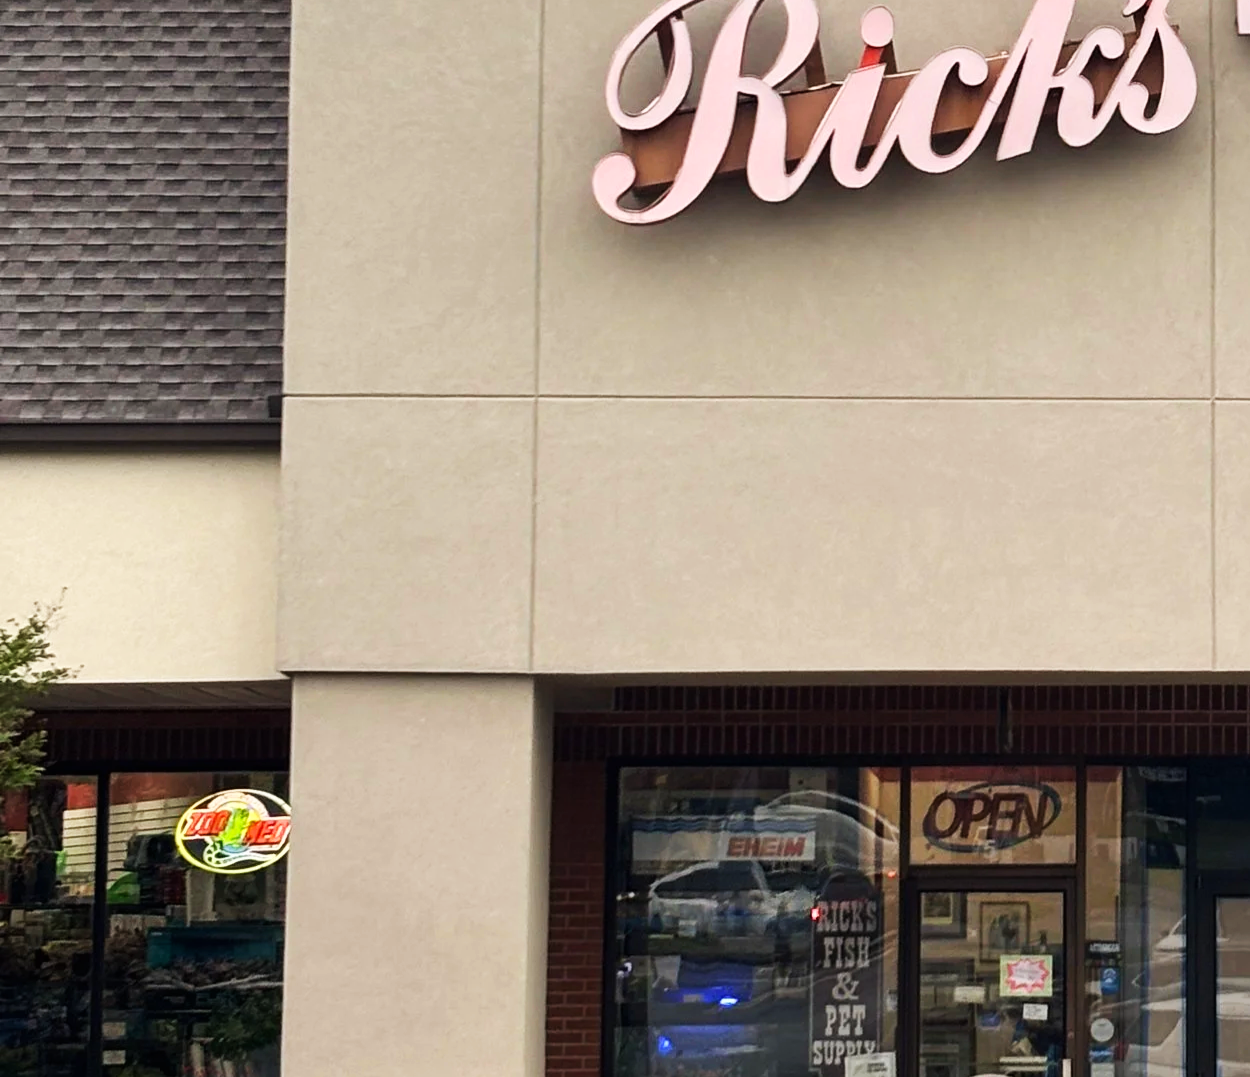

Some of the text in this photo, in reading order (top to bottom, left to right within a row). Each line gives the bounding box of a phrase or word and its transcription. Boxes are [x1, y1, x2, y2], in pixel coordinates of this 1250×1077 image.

[184, 809, 231, 838] ZOO
[922, 789, 1048, 840] OPEN
[726, 836, 807, 858] EHEIM
[822, 936, 871, 969] FISH
[831, 971, 860, 1001] &
[824, 1004, 866, 1037] PET
